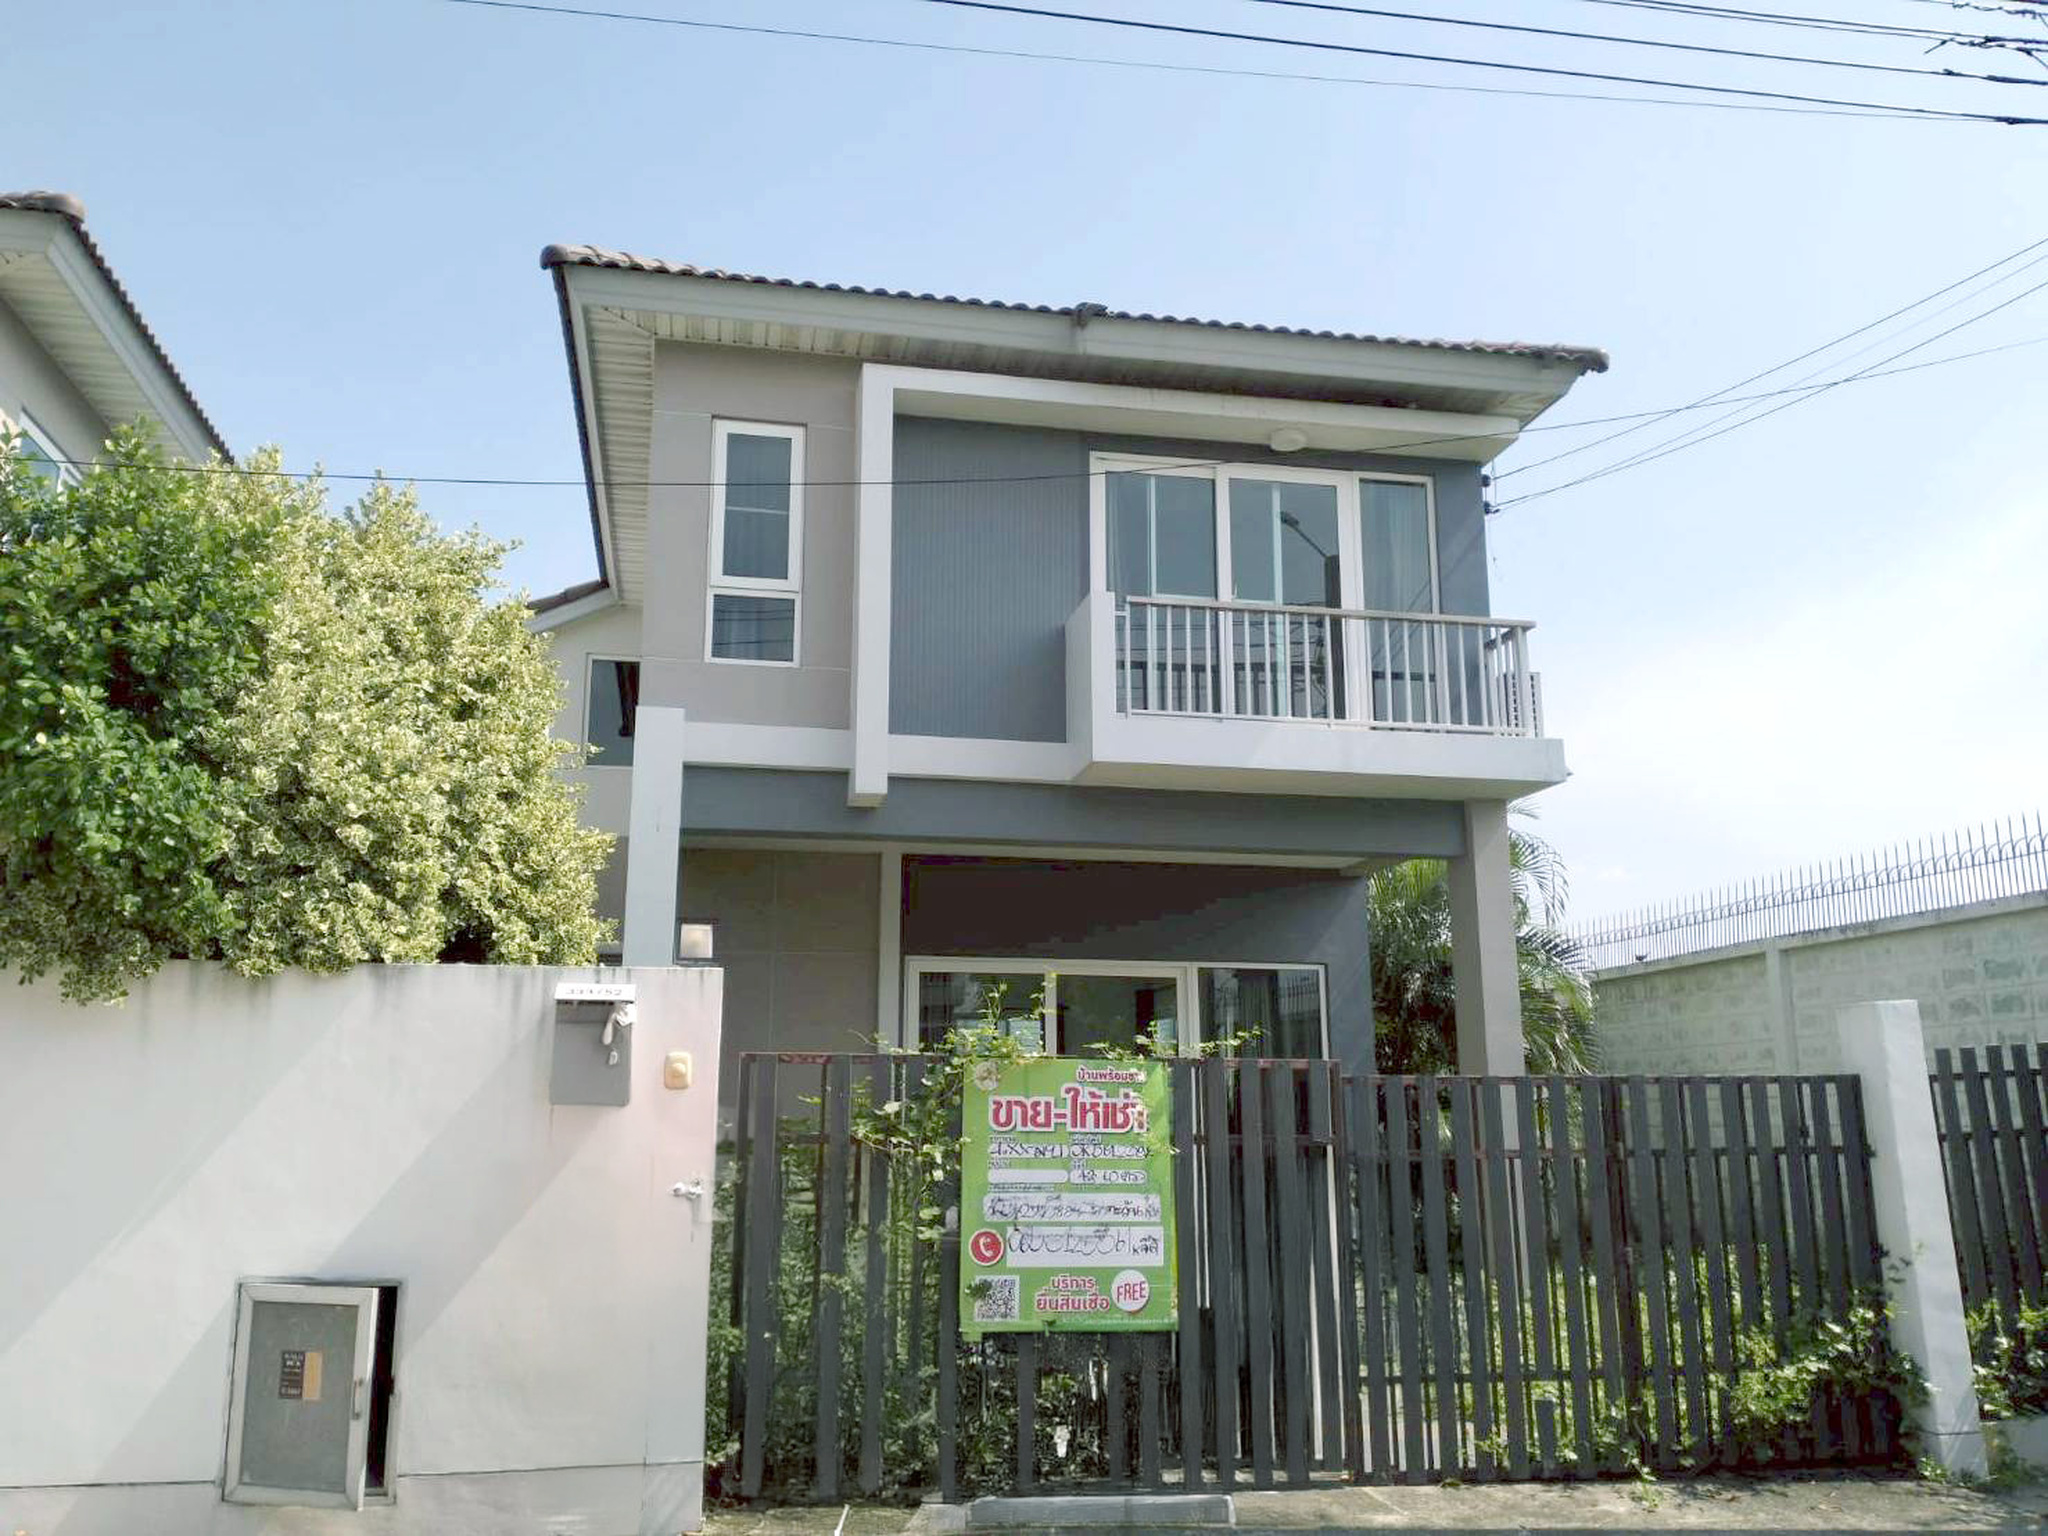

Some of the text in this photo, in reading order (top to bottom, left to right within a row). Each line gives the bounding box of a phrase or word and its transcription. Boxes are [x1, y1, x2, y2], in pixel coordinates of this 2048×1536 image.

[1077, 1066, 1145, 1082] บ้านพร้อมข
[1051, 1275, 1095, 1289] บริการ
[1116, 1281, 1147, 1302] FREE
